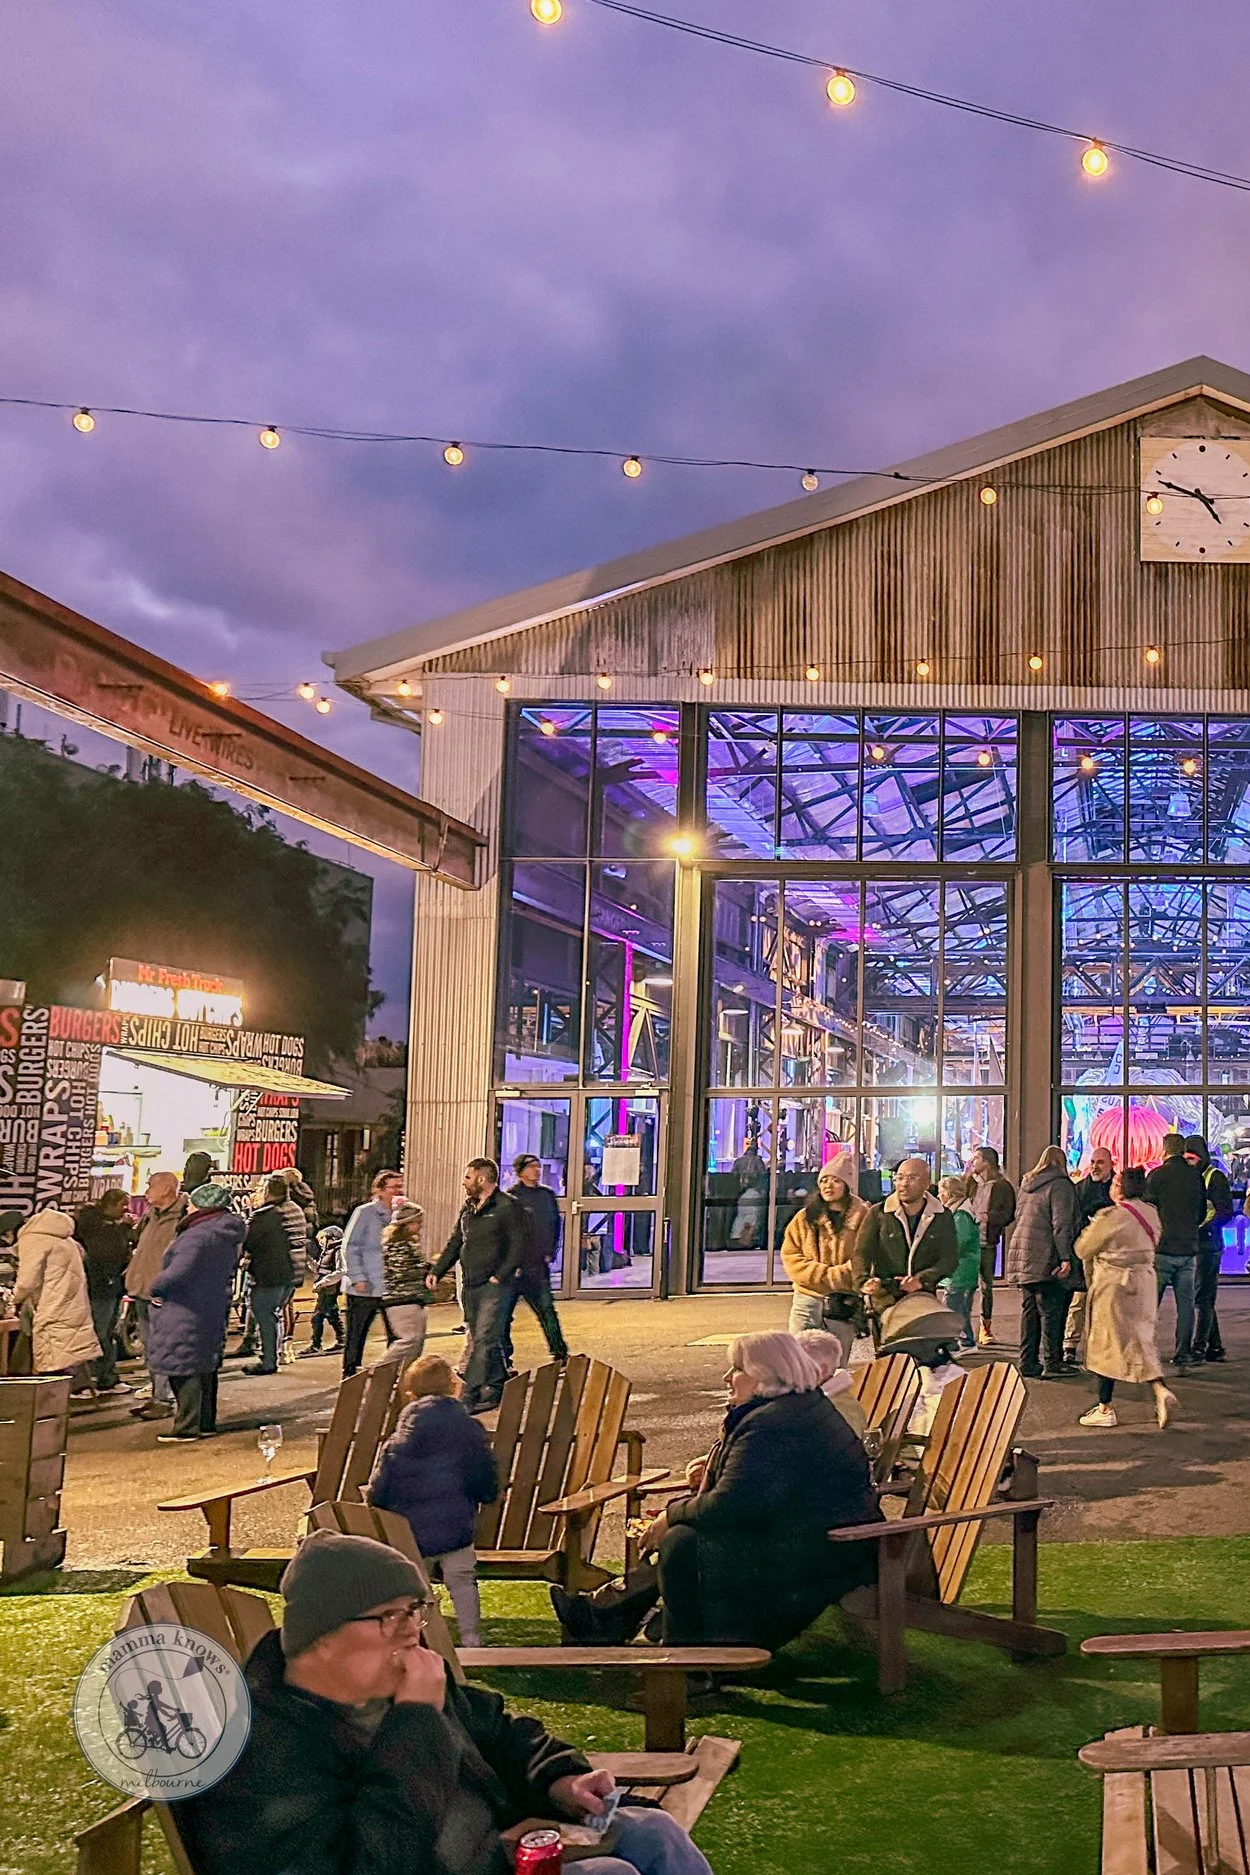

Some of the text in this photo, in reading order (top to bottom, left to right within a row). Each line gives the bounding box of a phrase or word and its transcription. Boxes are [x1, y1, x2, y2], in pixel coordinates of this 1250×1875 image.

[138, 964, 224, 993] Mr Fresh Truck
[48, 1005, 121, 1044] BURGERS
[129, 1016, 200, 1052] HOT CHIPS
[15, 1007, 50, 1103] BURGERS
[225, 1029, 263, 1058] WRAPS
[262, 1033, 281, 1055] HOT
[35, 1079, 71, 1201] WRAPS
[255, 1119, 298, 1142] BURGERS
[78, 1119, 95, 1188] BURGERS
[233, 1142, 297, 1173] HOT DOGS
